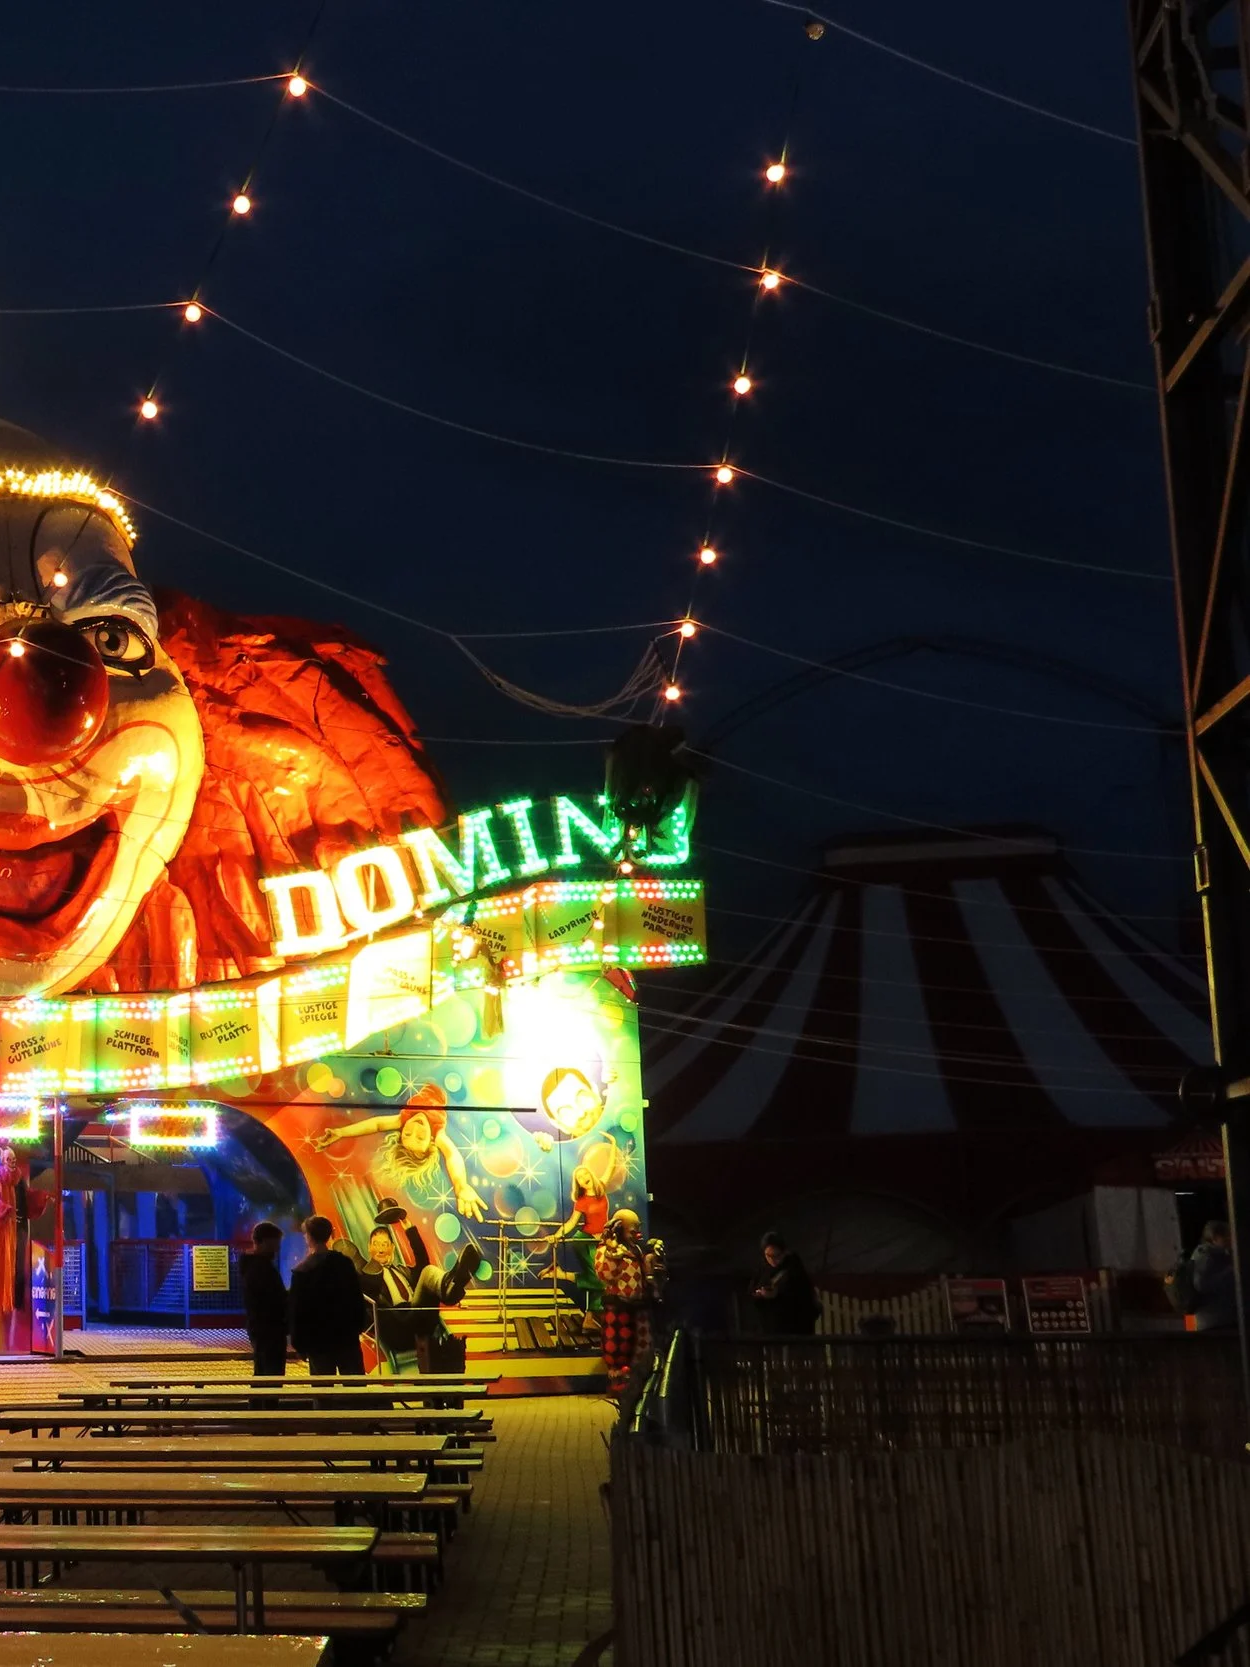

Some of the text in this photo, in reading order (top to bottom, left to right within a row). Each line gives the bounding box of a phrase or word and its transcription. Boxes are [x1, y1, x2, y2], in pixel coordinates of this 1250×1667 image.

[648, 904, 693, 924] LUSTIGER
[298, 1000, 338, 1015] LUSTIGE
[300, 1011, 338, 1025] SPIEGEL
[217, 1024, 251, 1044] PLATTE
[8, 1038, 62, 1064] GUTE LAUNE
[10, 1037, 38, 1053] SPASS
[106, 1037, 160, 1058] PLATTFORM
